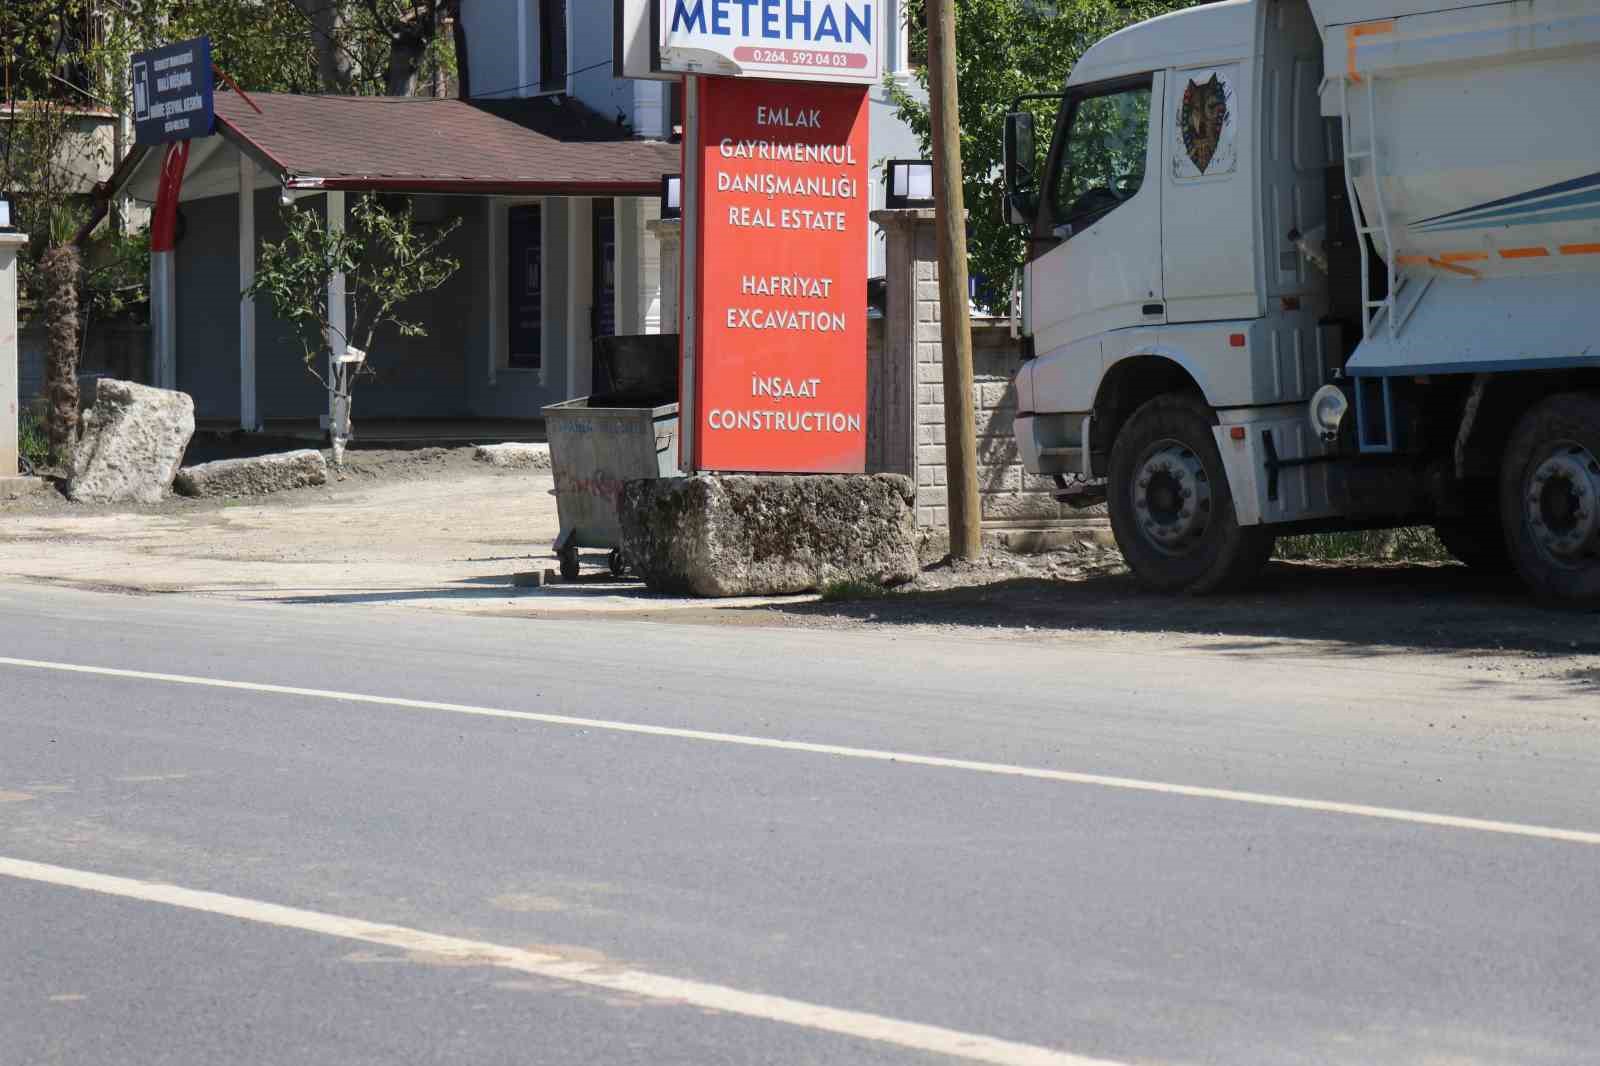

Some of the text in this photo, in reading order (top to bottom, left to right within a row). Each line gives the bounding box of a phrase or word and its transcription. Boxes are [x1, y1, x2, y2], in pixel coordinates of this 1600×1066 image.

[671, 0, 871, 45] METEHAN
[753, 49, 848, 67] 0.264. 592 04 03
[757, 105, 822, 129] EMLAK
[719, 136, 857, 165] GAYRİMENKUL
[717, 171, 857, 199] DANIŞMANLIĞI
[728, 206, 846, 231] REAL ESTATE
[741, 273, 833, 298] HAFRİYAT
[727, 307, 846, 332] EXCAVATION
[751, 371, 821, 402] İNŞAAT
[708, 408, 861, 432] CONSTRUCTION
